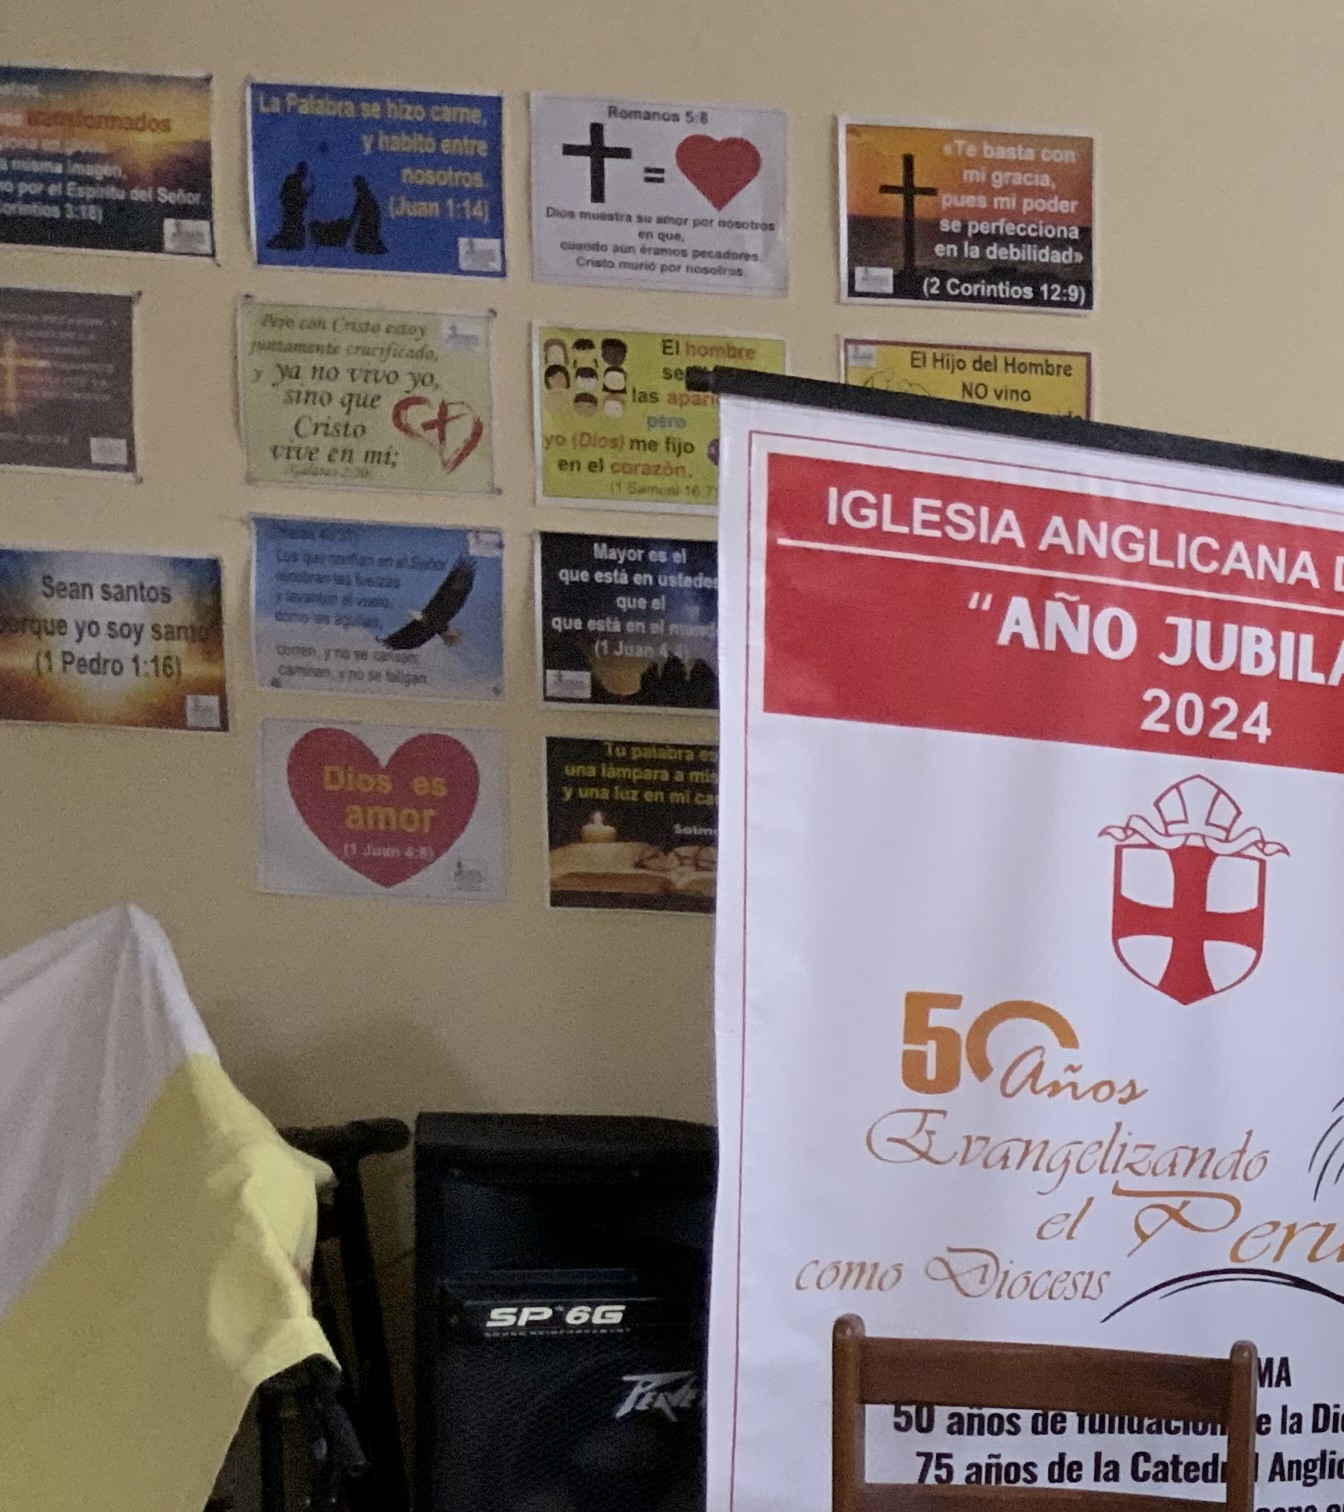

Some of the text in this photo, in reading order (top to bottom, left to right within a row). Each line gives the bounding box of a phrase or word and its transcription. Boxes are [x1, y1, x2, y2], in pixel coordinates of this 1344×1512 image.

[259, 93, 280, 113] La
[286, 93, 356, 118] Palabra
[361, 101, 381, 118] se
[387, 98, 426, 121] hizo
[608, 105, 681, 123] Romanos
[362, 129, 488, 157] y habitó entre
[983, 141, 1077, 165] basta con
[963, 166, 1056, 190] mi gracia,
[18, 181, 152, 203] por del
[389, 195, 489, 224] (Juan 1:14)
[941, 193, 1079, 216] pues mi poder
[636, 214, 714, 230] su amor por
[939, 218, 1080, 240] se perfecciona
[637, 229, 654, 240] en
[934, 241, 1084, 265] en la debilidad»
[660, 262, 682, 275] por
[923, 276, 1086, 306] (2 Corintios 12:9)
[262, 313, 295, 331] Pero
[300, 319, 326, 332] con
[332, 316, 381, 334] Cristo
[385, 320, 427, 342] estoy
[661, 339, 757, 360] El hombre
[910, 350, 1073, 377] El Hijo del Hombre
[272, 363, 440, 394] ya no vivo yo,
[284, 386, 381, 416] sino que
[631, 387, 659, 405] las
[961, 382, 1032, 402] NO vino
[294, 414, 367, 440] Cristo
[646, 414, 688, 433] pero
[270, 441, 320, 463] vive
[327, 447, 354, 463] en
[543, 431, 695, 457] yo (Dios) me fijo
[558, 458, 581, 472] en
[587, 457, 604, 473] el
[627, 482, 681, 498] Samuel
[827, 486, 1026, 549] IGLESIA
[1038, 515, 1320, 589] ANGLICANA
[593, 542, 688, 564] Mayor es el
[41, 574, 172, 604] Sean santos
[558, 568, 589, 585] que
[594, 568, 629, 585] está
[633, 573, 653, 586] en
[616, 595, 666, 612] que el
[74, 618, 144, 646] yo soy
[551, 616, 666, 635] que está en el
[594, 639, 655, 659] (1 Juan
[35, 650, 183, 685] (1 Pedro 1:16)
[1140, 688, 1272, 744] 2024
[630, 744, 695, 761] palabra
[321, 764, 448, 797] Dios es
[564, 762, 670, 784] una lámpara
[578, 785, 691, 805] una luz en mi
[345, 804, 436, 833] amor
[1000, 1045, 1148, 1105] Años
[865, 1107, 1271, 1196] Evangelizando
[1036, 1196, 1094, 1241] el
[795, 1245, 1111, 1301] como Diocesis
[565, 1304, 627, 1325] 6G
[894, 1405, 935, 1434] 50
[947, 1407, 1021, 1436] años
[1031, 1410, 1067, 1436] de
[1255, 1411, 1271, 1435] e
[1280, 1404, 1303, 1435] la
[915, 1451, 954, 1484] 75
[965, 1453, 1038, 1485] años
[1047, 1452, 1083, 1484] de
[1093, 1451, 1121, 1483] la
[1131, 1450, 1259, 1484] Catedl
